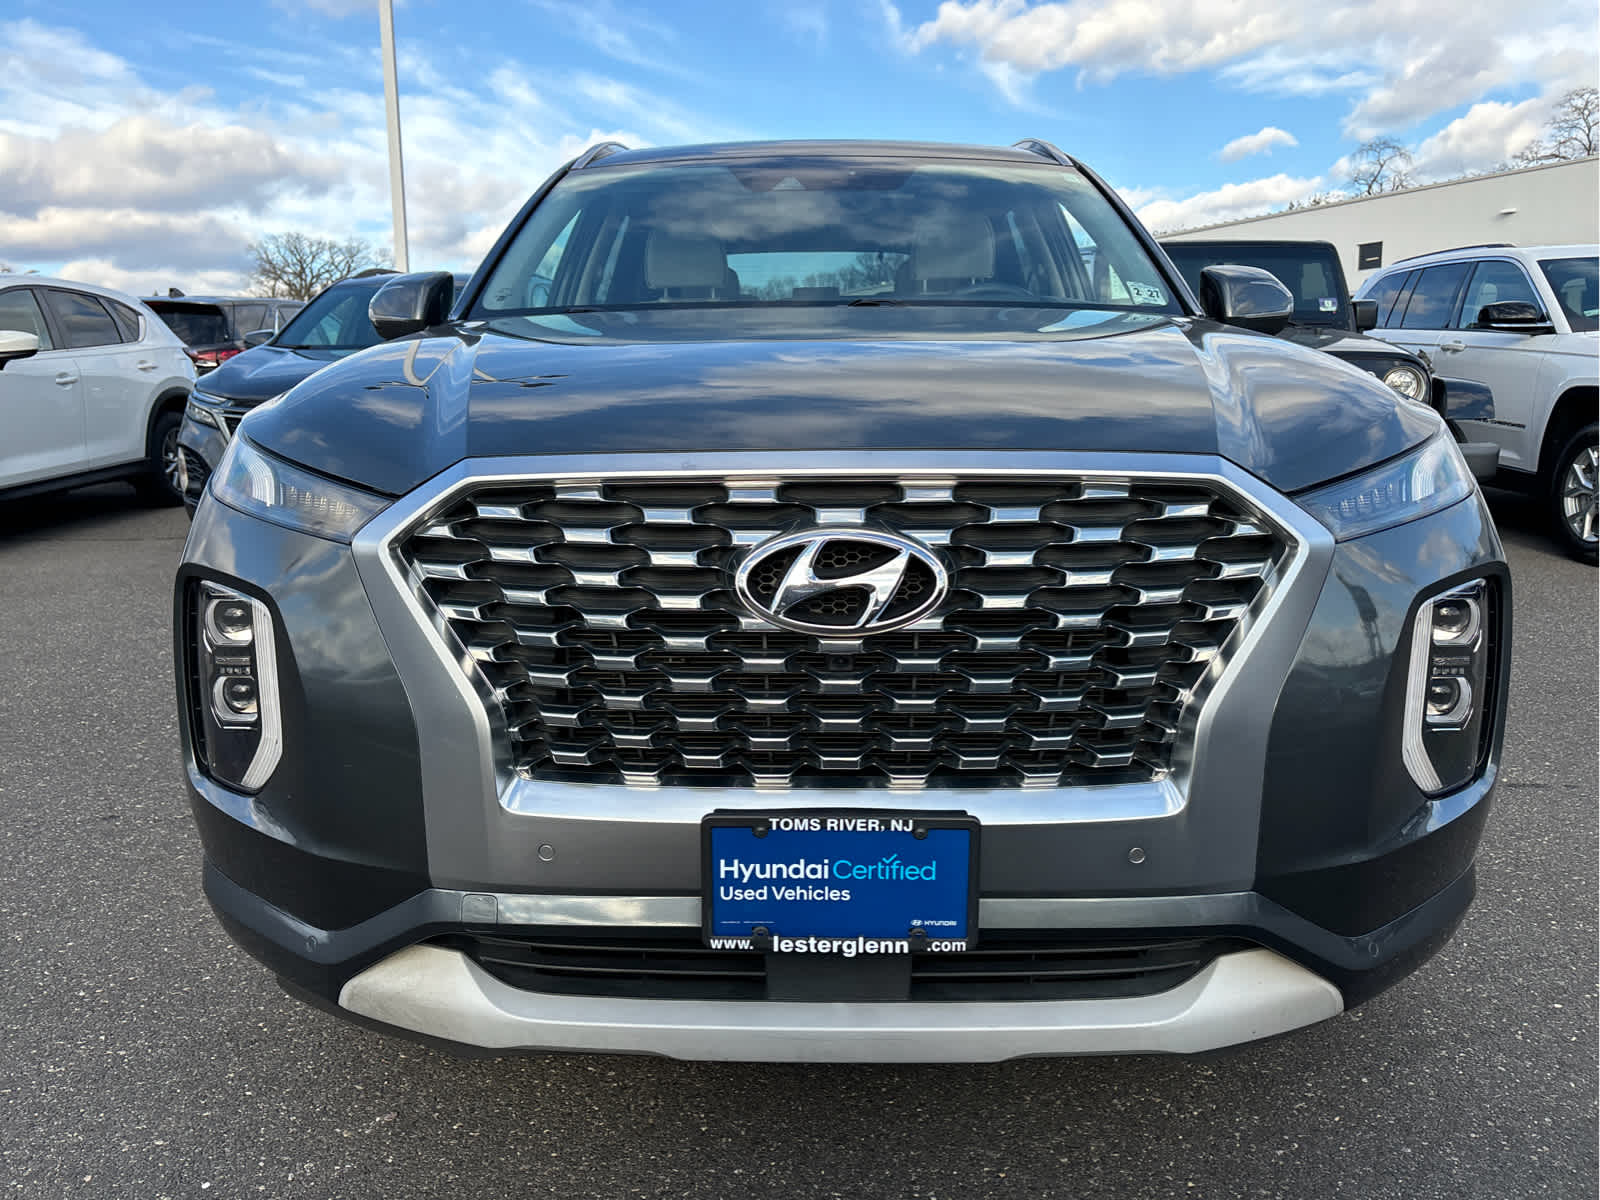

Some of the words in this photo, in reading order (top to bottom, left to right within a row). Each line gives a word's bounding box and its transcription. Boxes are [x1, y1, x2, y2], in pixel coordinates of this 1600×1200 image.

[1133, 287, 1142, 296] 2
[1147, 289, 1160, 299] 27
[769, 818, 821, 832] TOMS
[827, 818, 885, 833] RIVER,
[891, 819, 913, 832] NJ
[719, 858, 829, 883] Hyundai
[832, 854, 937, 881] Certified
[720, 885, 768, 901] Used
[771, 885, 851, 901] Vehicles
[710, 938, 754, 950] www.
[773, 935, 909, 957] lesterglenn
[926, 940, 967, 952] .com
